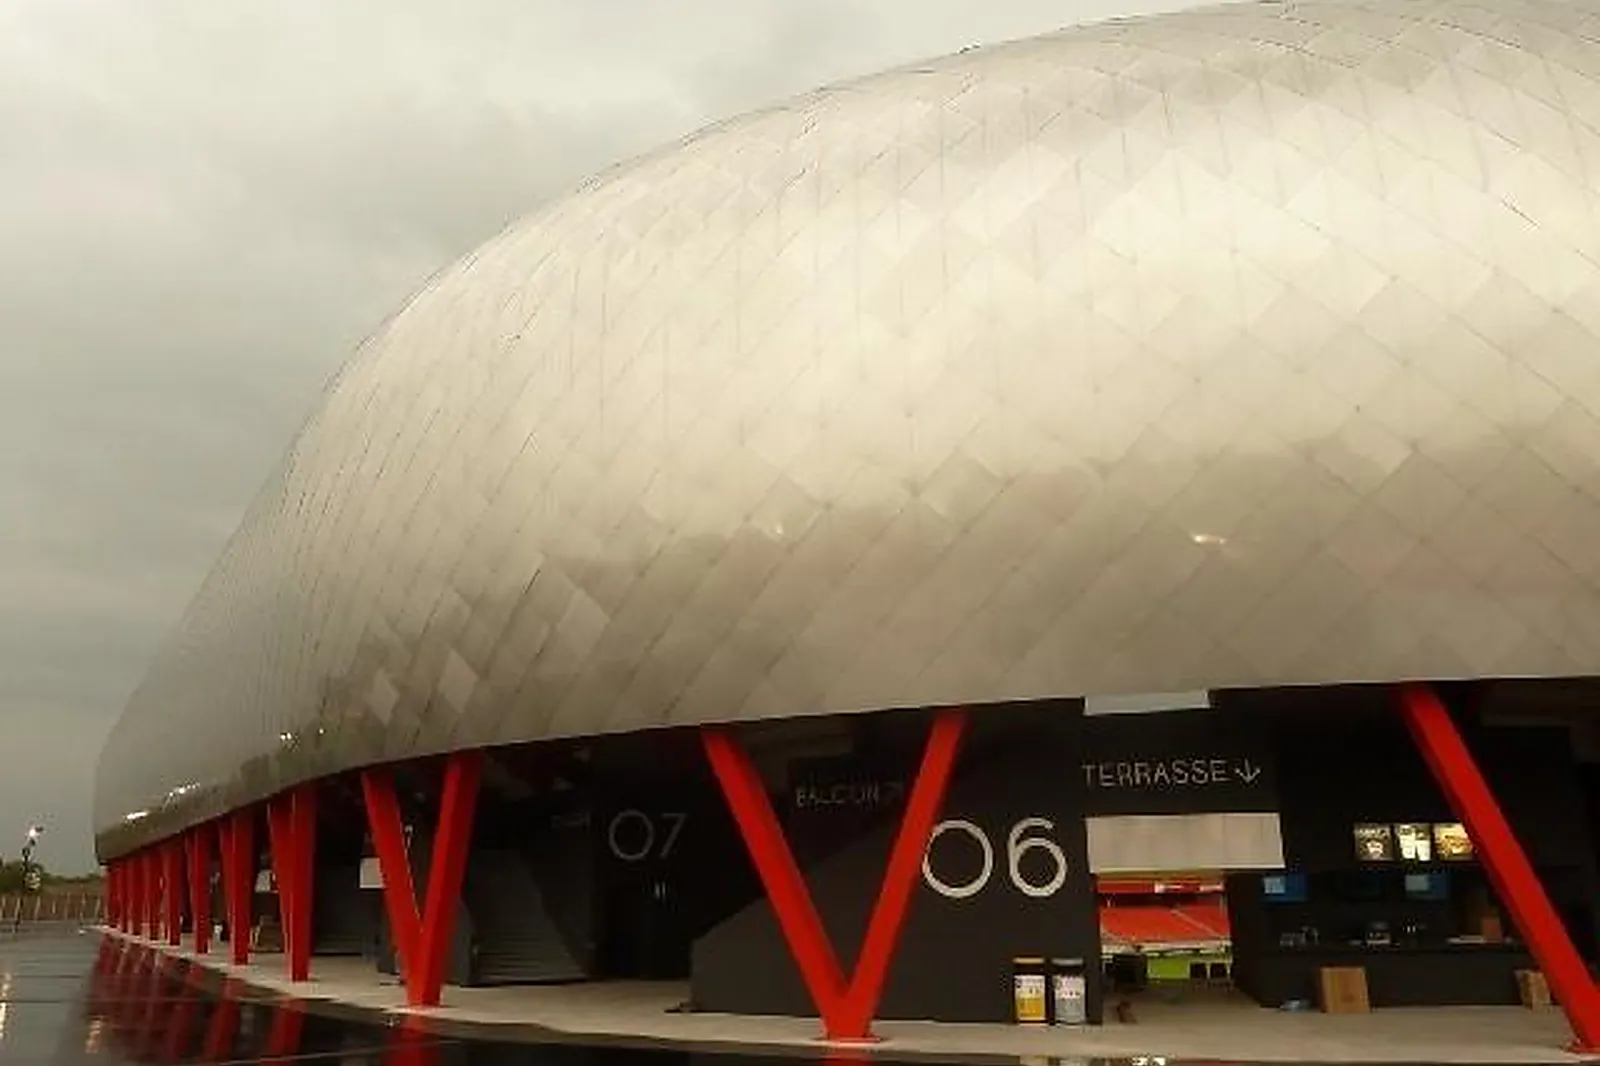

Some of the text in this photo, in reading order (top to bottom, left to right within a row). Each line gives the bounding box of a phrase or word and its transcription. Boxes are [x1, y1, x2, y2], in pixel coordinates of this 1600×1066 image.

[1080, 759, 1232, 789] TERRASSE
[608, 808, 688, 861] 07
[921, 817, 1068, 899] 06
